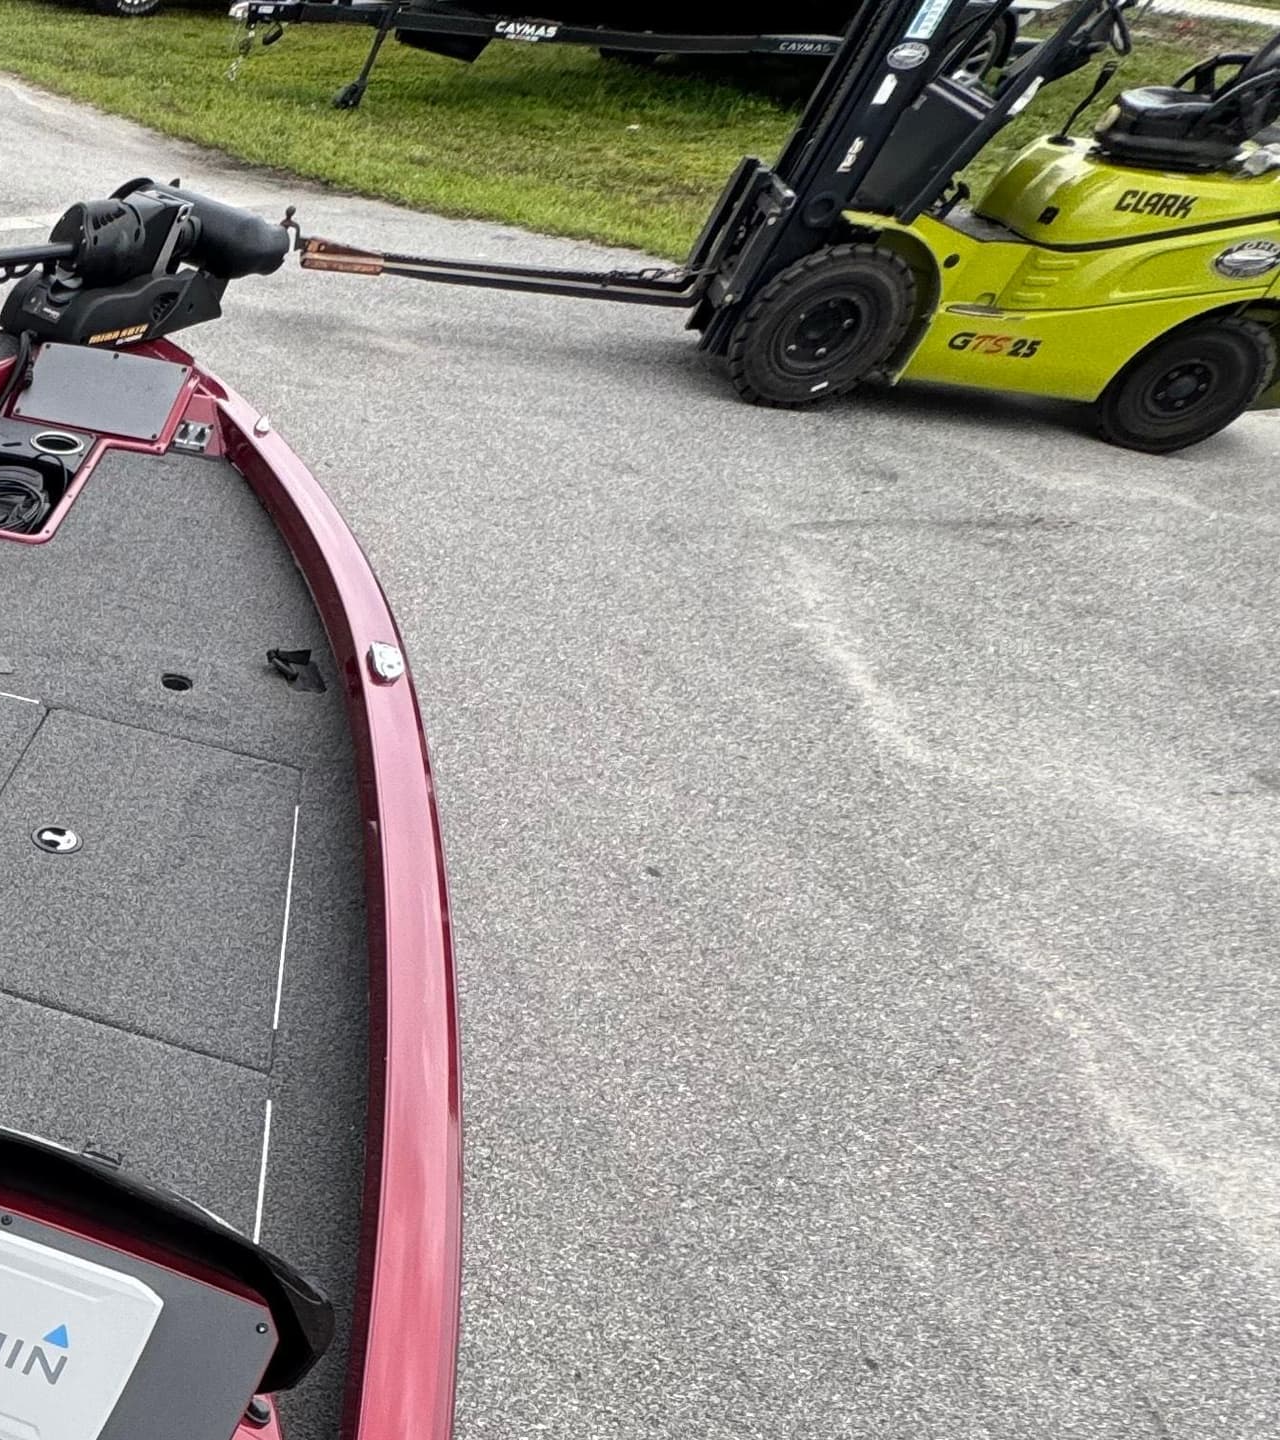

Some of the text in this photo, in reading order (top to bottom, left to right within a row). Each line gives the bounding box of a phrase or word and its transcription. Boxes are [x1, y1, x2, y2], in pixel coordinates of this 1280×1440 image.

[495, 21, 558, 37] CAYMAS
[778, 41, 831, 53] CAYMAS
[1114, 189, 1199, 219] CLARK
[948, 332, 1042, 358] GTS 25
